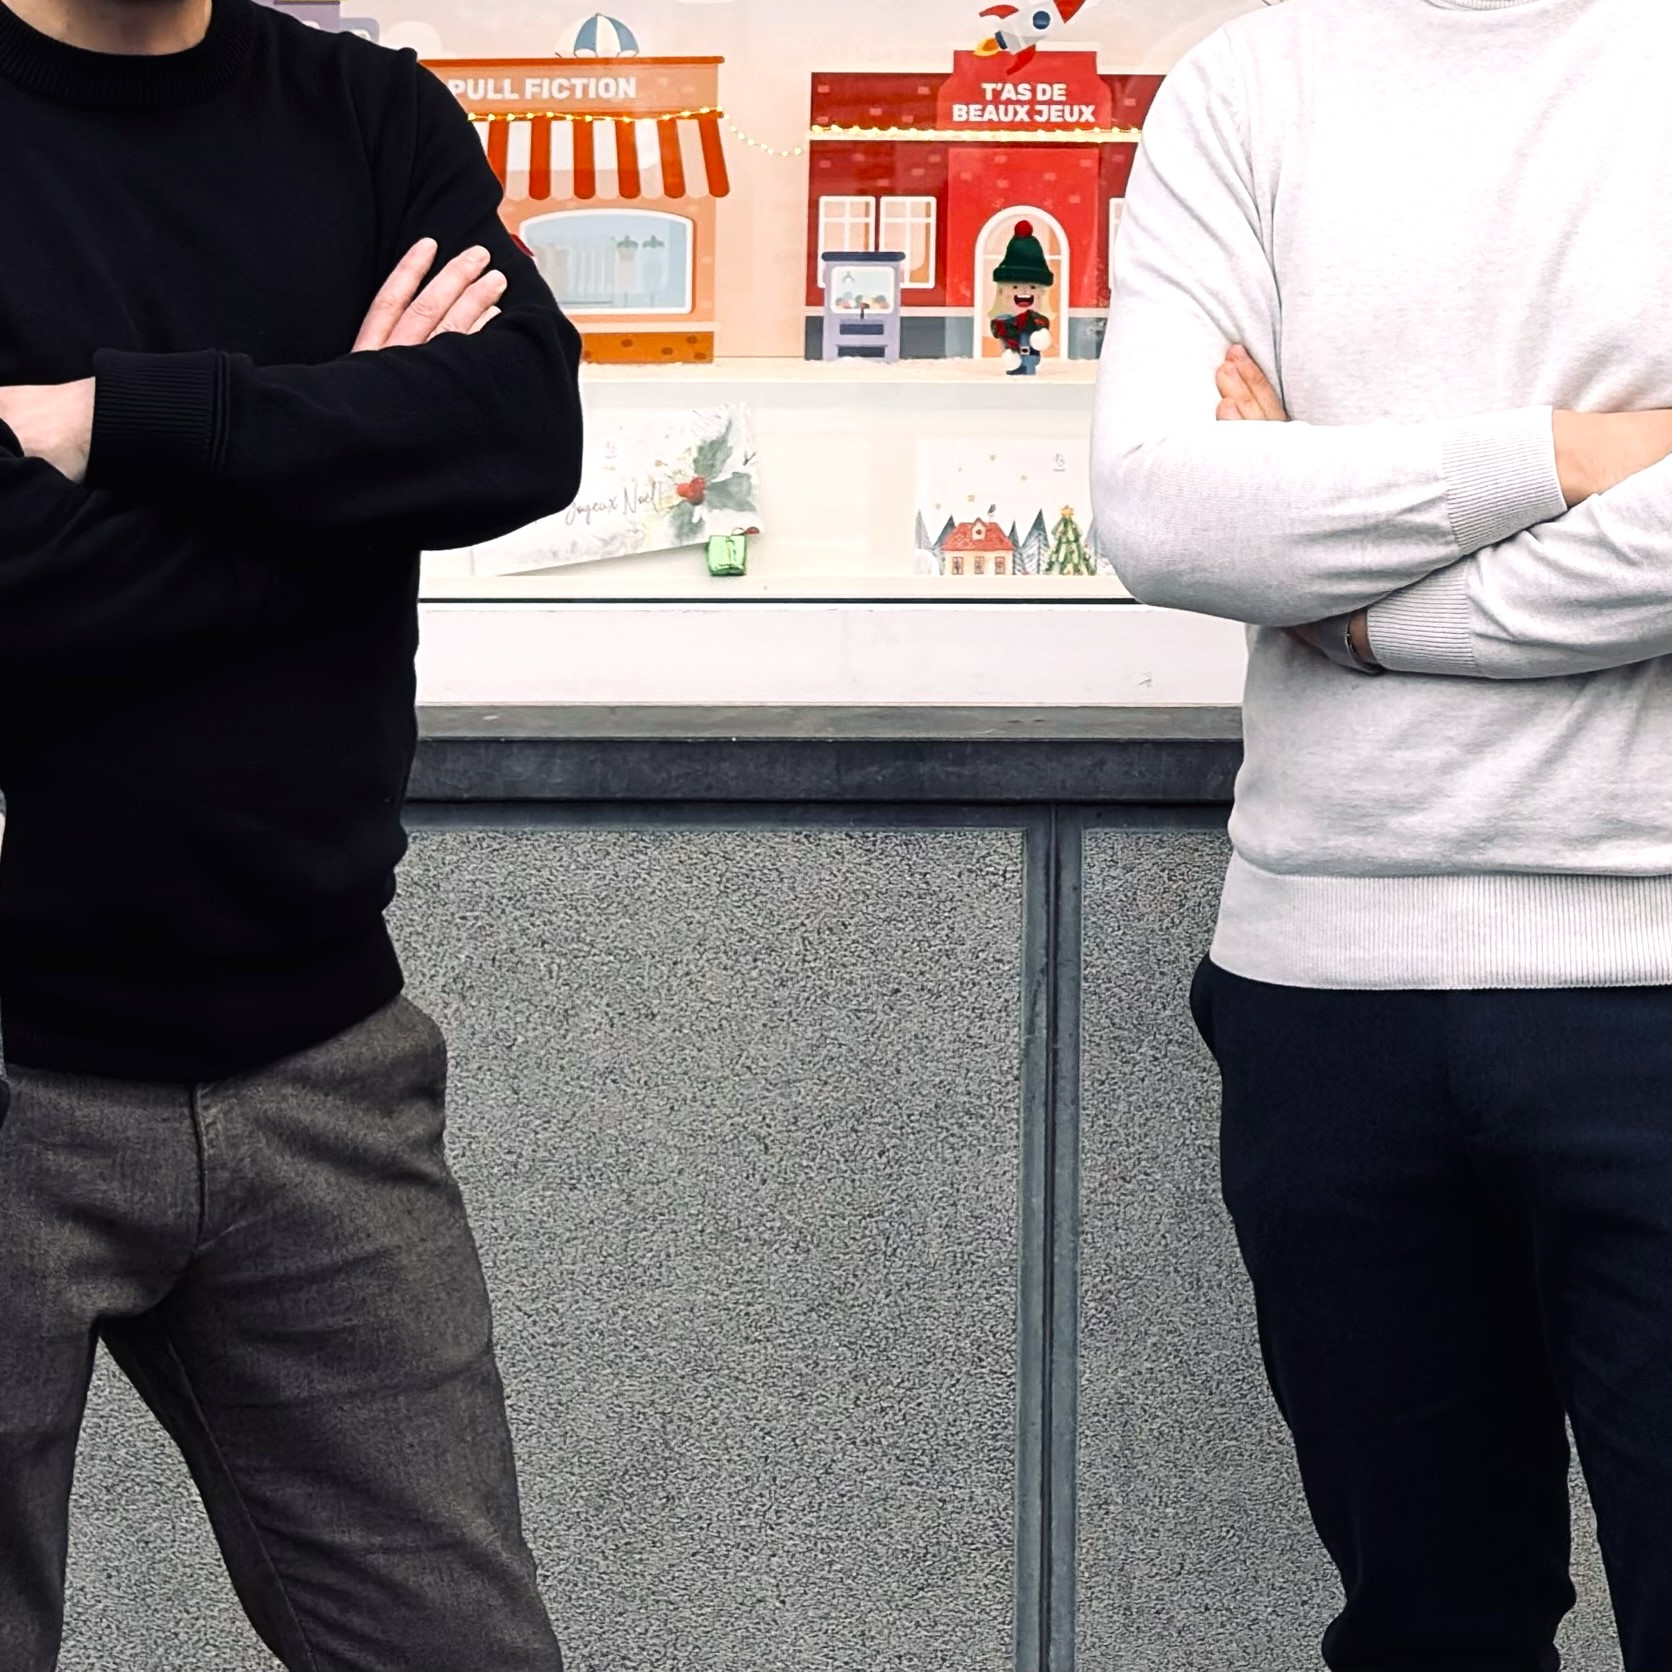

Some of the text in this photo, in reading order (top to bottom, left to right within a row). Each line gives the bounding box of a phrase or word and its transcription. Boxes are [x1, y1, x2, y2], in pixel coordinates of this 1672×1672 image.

[447, 76, 637, 101] PULL FICTION
[981, 82, 1067, 101] T'AS DE
[952, 104, 1096, 123] BEAUX JEUX
